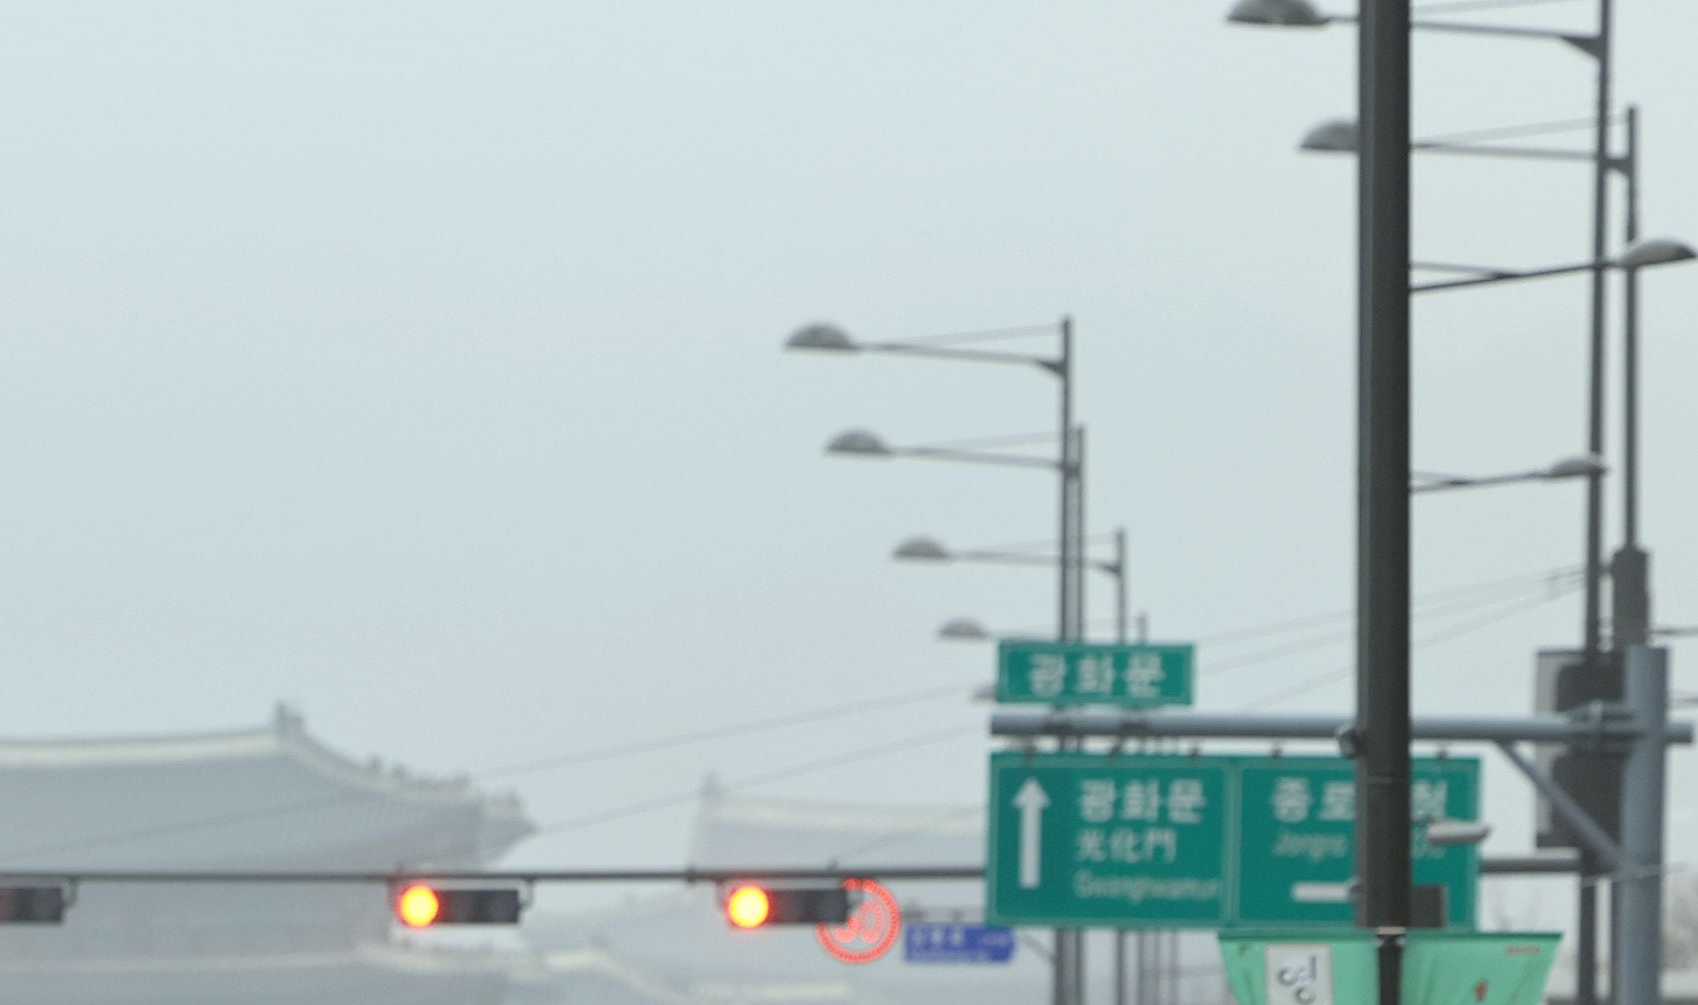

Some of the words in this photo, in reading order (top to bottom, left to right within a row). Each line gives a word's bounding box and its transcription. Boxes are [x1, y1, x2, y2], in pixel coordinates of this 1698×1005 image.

[1029, 653, 1165, 698] 광화문
[1079, 779, 1207, 825] 광화문
[1076, 827, 1177, 864] 光化門
